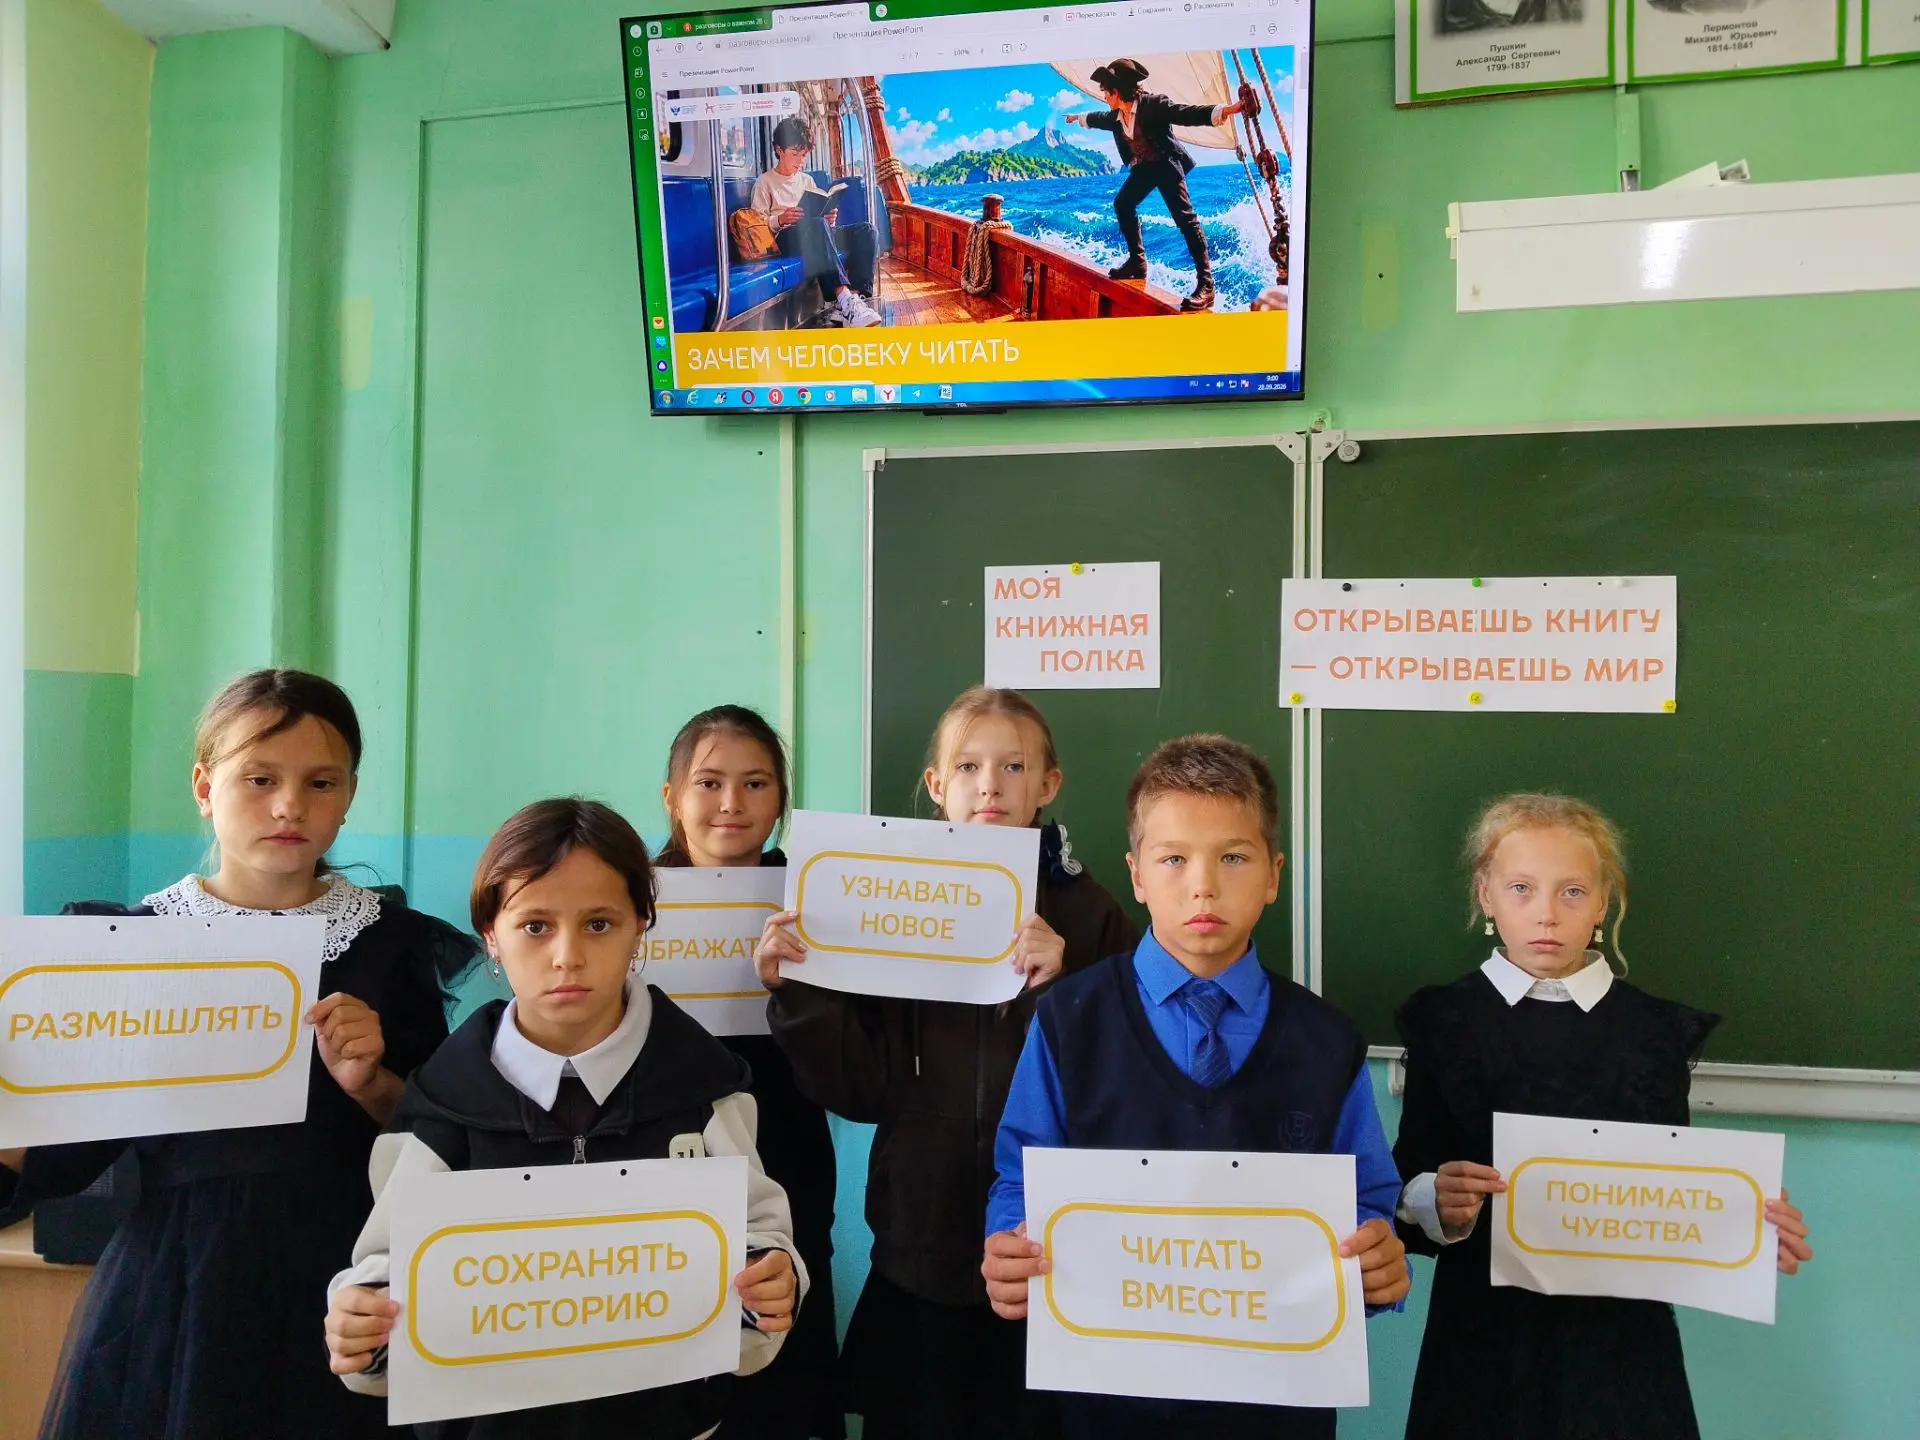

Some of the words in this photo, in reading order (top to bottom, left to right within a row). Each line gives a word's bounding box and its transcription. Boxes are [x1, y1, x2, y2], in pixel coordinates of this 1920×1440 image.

[833, 29, 882, 40] Презентация
[882, 25, 924, 36] PowerPoint
[1684, 34, 1722, 45] Михаил
[1730, 29, 1777, 41] Юрьевич
[1703, 21, 1758, 33] Лермонтов
[1455, 53, 1507, 67] Александр
[1511, 49, 1561, 61] Сергеевич
[1489, 42, 1526, 53] Пушкин
[1707, 40, 1753, 53] 1814-1841
[1486, 60, 1531, 72] 1799-1837
[687, 346, 771, 371] ЗАЧЕМ
[777, 342, 912, 369] ЧЕЛОВЕКУ
[919, 338, 1020, 366] ЧИТАТЬ
[993, 577, 1061, 600] МОЯ
[995, 612, 1149, 638] КНИЖНАЯ
[1293, 607, 1533, 634] ОТКРЫВАЕШЬ
[1545, 607, 1662, 634] КНИГУ
[1039, 649, 1145, 673] ПОЛКА
[1327, 655, 1573, 683] ОТКРЫВАЕШЬ
[1583, 657, 1665, 683] МИР
[840, 873, 983, 907] УЗНАВАТЬ
[860, 911, 957, 940] НОВОЕ
[8, 1004, 283, 1042] РАЗМЫШЛЯТЬ
[1545, 1180, 1724, 1212] ПОНИМАТЬ
[1561, 1215, 1703, 1244] ЧУВСТВА
[452, 1242, 688, 1288] СОХРАНЯТЬ
[1120, 1234, 1263, 1271] ЧИТАТЬ
[470, 1289, 670, 1335] ИСТОРИЮ
[1121, 1279, 1268, 1321] ВМЕСТЕ
